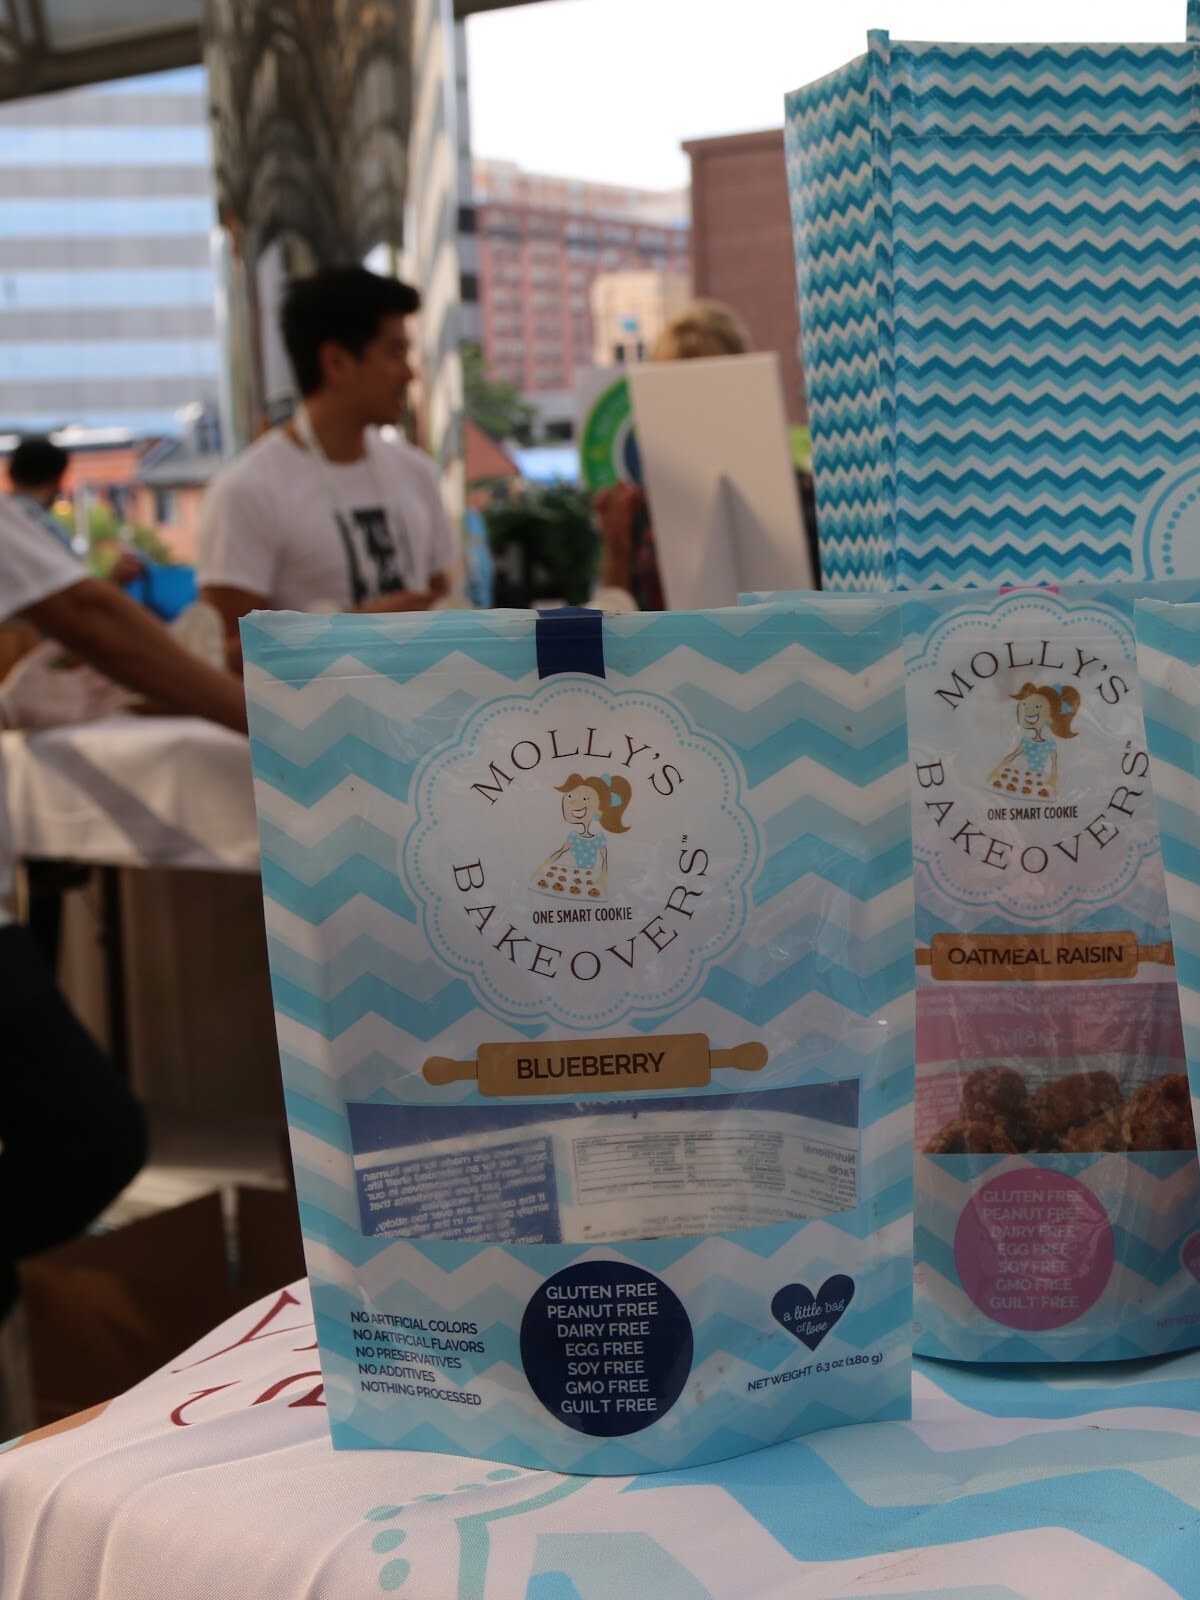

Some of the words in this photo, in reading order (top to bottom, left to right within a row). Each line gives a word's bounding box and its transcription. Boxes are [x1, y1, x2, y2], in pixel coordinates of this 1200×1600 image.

[934, 640, 1130, 711] MOLLY'S
[470, 727, 684, 805] MOLLY'S
[987, 808, 1007, 821] ONE
[1010, 807, 1041, 820] SMART
[1044, 805, 1078, 819] COOKIE
[533, 911, 554, 924] ONE
[557, 909, 591, 923] SMART
[595, 907, 632, 921] COOKIE
[947, 948, 1051, 965] OATMEAL
[1057, 945, 1123, 964] RAISIN
[517, 1052, 665, 1079] BLUEBERRY
[983, 1190, 1043, 1202] GLUTEN
[1047, 1190, 1083, 1202] FREE
[983, 1208, 1044, 1220] PEANUT
[1047, 1207, 1085, 1220] FREE
[991, 1225, 1035, 1238] DAIRY
[1038, 1224, 1075, 1238] FREE
[998, 1243, 1028, 1256] EGG
[1032, 1242, 1069, 1255] FREE
[999, 1262, 1028, 1273] SOY
[1032, 1261, 1069, 1273] FREE
[546, 1285, 611, 1299] GLUTEN
[616, 1282, 657, 1298] FREE
[996, 1279, 1032, 1291] GMO
[1036, 1279, 1072, 1291] FREE
[547, 1304, 613, 1319] PEANUT
[617, 1302, 658, 1317] FREE
[783, 1312, 792, 1321] a
[794, 1302, 822, 1320] little
[825, 1299, 845, 1313] bag
[991, 1296, 1037, 1309] GUILT
[1040, 1296, 1078, 1308] FREE
[351, 1311, 369, 1323] NO
[371, 1314, 428, 1331] ARTIFICIAL
[428, 1320, 477, 1334] COLORS
[557, 1323, 605, 1338] DAIRY
[609, 1321, 650, 1336] FREE
[796, 1322, 806, 1333] of
[806, 1321, 828, 1335] love
[353, 1329, 371, 1340] NO
[374, 1330, 430, 1348] ARTIFICIAL
[431, 1338, 485, 1353] FLAVORS
[565, 1343, 599, 1357] EGG
[602, 1341, 644, 1355] FREE
[356, 1347, 375, 1358] NO
[377, 1348, 461, 1368] PRESERVATIVES
[358, 1364, 377, 1374] NO
[380, 1366, 435, 1382] ADDITIVES
[568, 1362, 600, 1376] SOY
[604, 1360, 644, 1374] FREE
[748, 1378, 770, 1391] NET
[770, 1365, 813, 1385] WEIGHT
[816, 1362, 830, 1372] 6.3
[831, 1360, 844, 1369] oz
[846, 1355, 869, 1367] (180
[871, 1353, 883, 1366] g)
[360, 1381, 415, 1396] NOTHING
[417, 1386, 481, 1405] PROCESSED
[565, 1381, 604, 1394] GMO
[608, 1379, 649, 1393] FREE
[561, 1400, 610, 1414] GUILT
[616, 1398, 657, 1413] FREE
